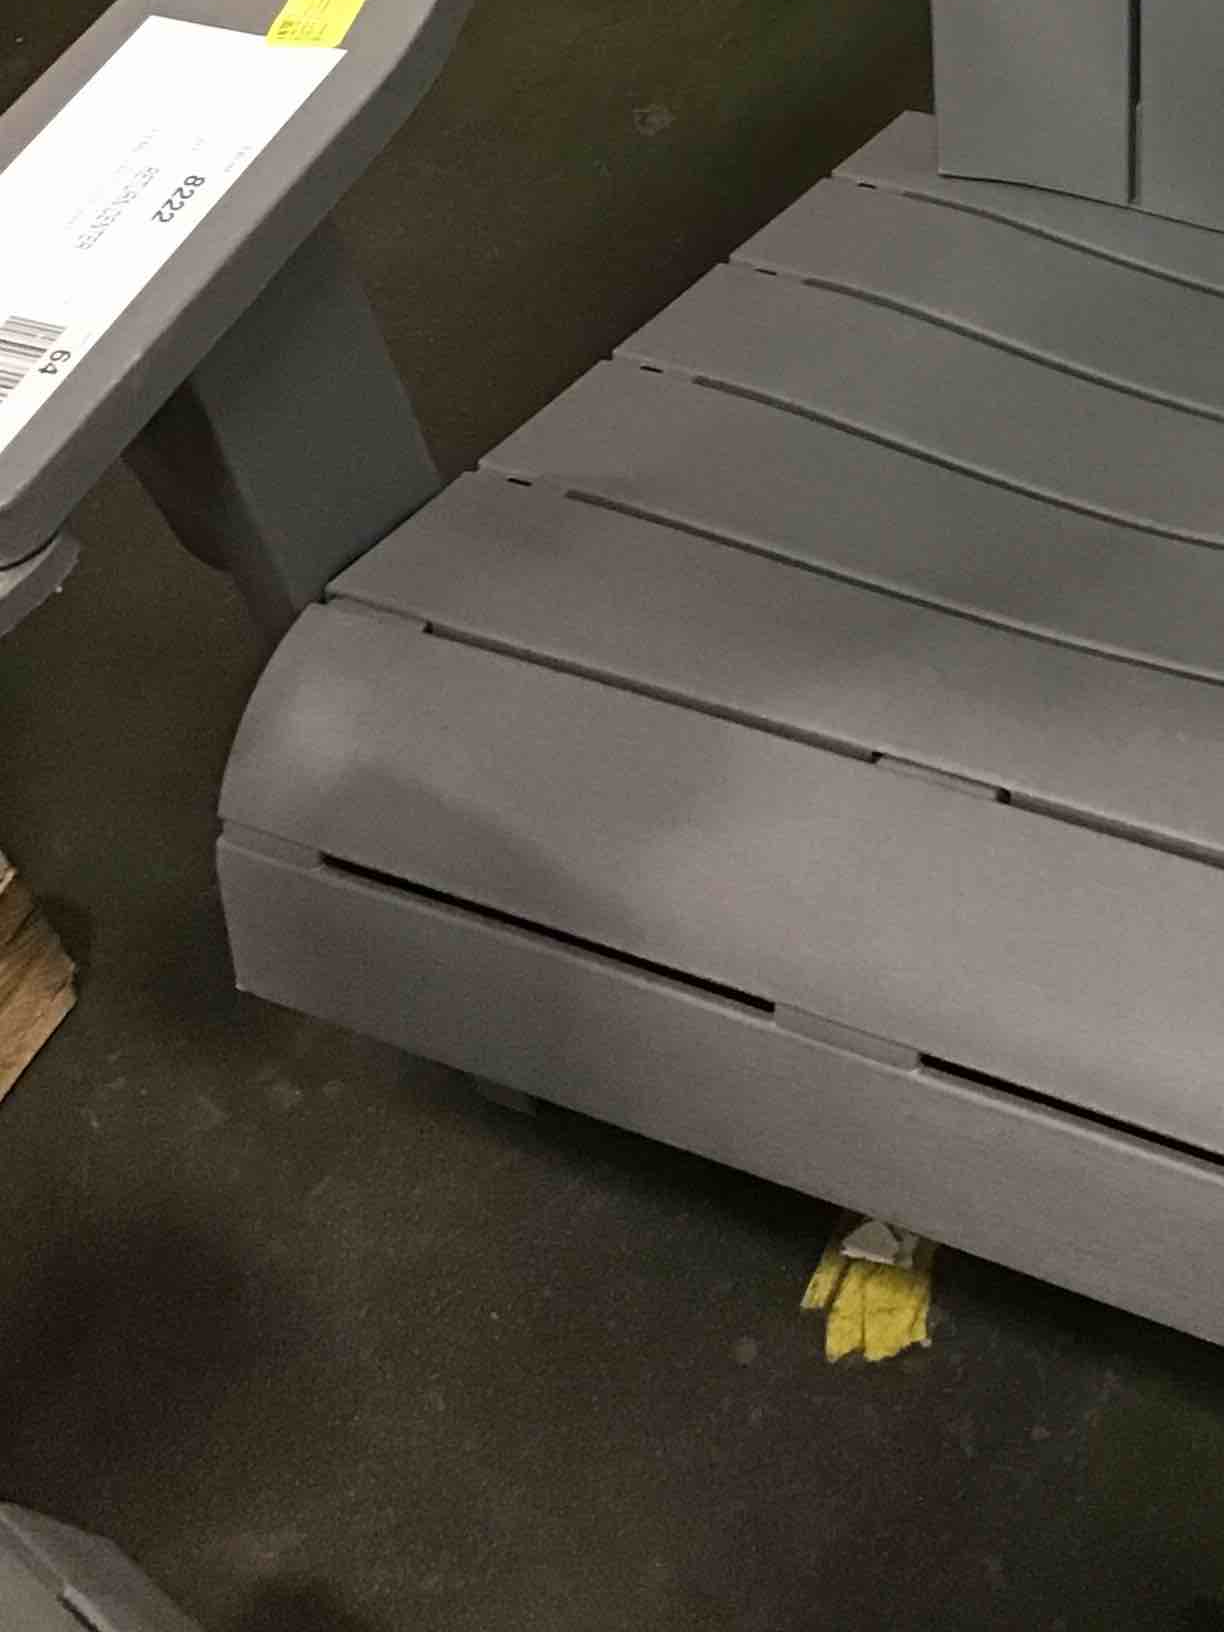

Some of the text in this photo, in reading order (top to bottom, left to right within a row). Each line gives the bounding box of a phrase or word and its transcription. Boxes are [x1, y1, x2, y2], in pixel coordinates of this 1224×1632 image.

[151, 173, 206, 225] 8222
[77, 208, 122, 249] CENTER
[37, 348, 72, 377] 64
